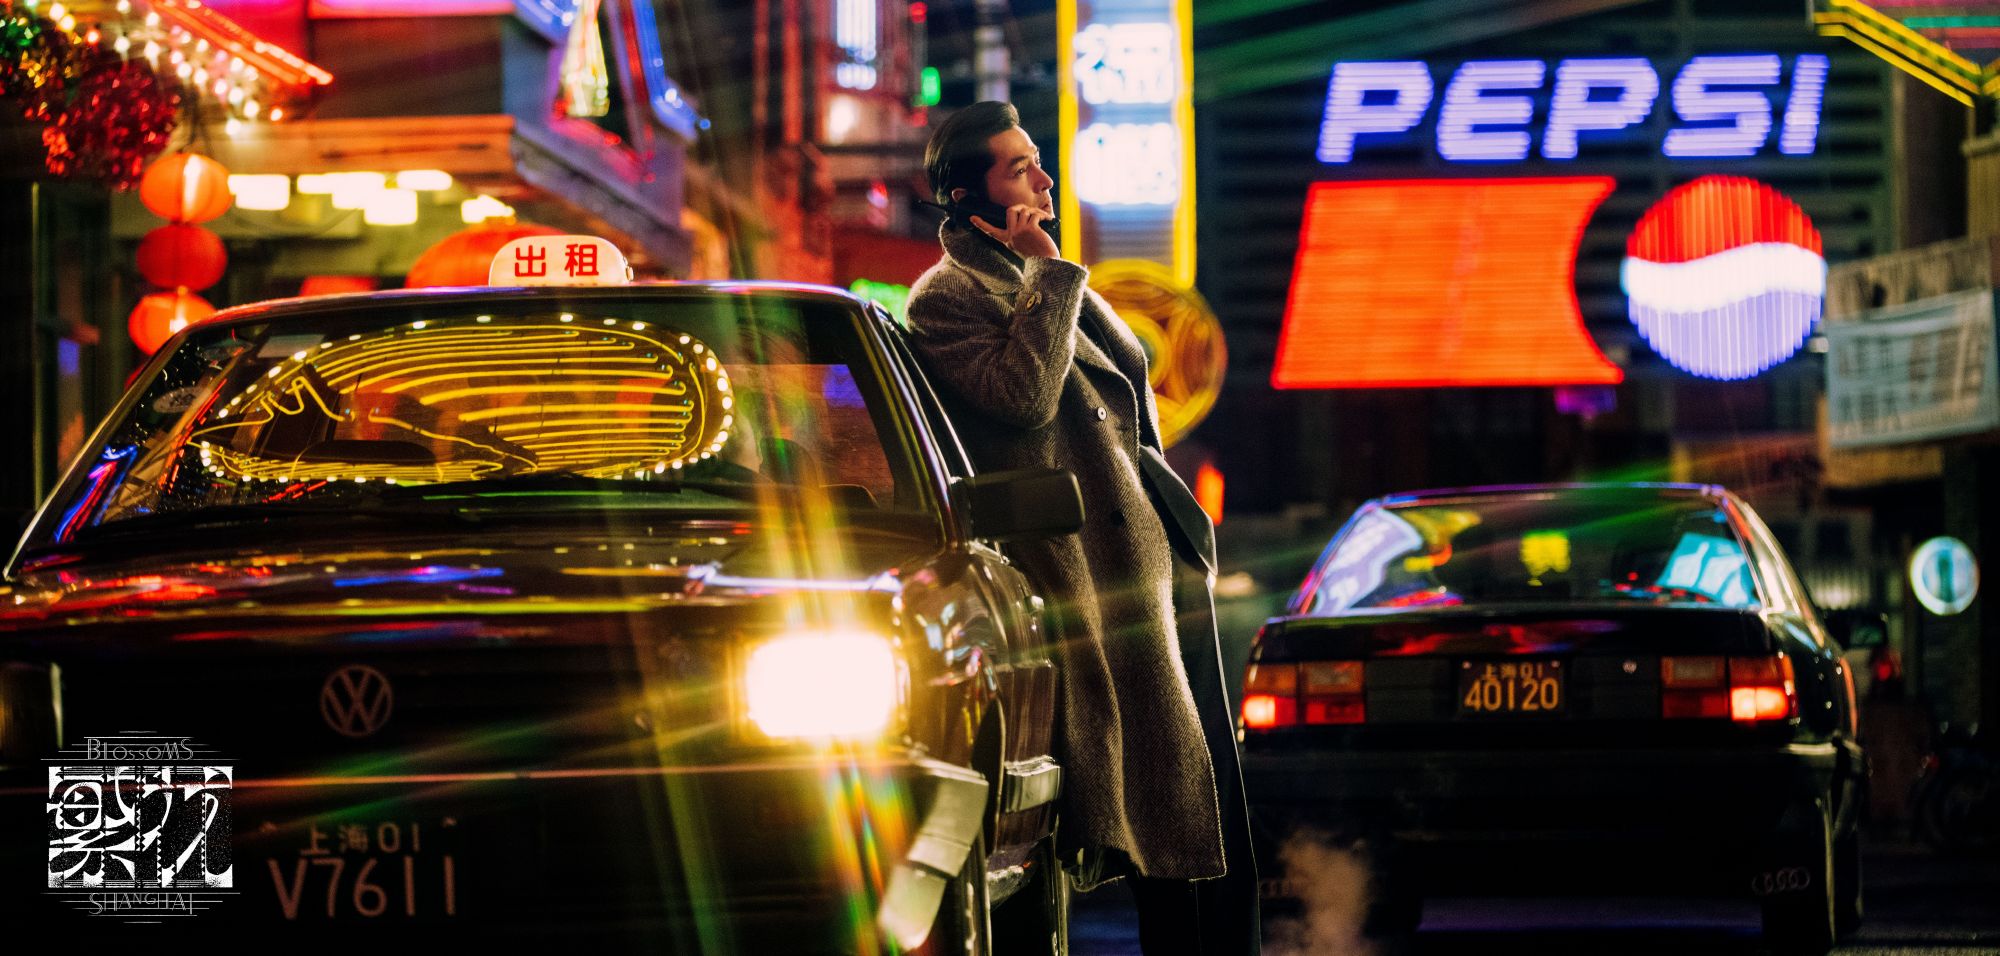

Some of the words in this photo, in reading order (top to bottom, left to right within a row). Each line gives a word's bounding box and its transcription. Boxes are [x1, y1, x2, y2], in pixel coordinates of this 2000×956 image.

[1315, 53, 1829, 164] PEPSI
[514, 243, 599, 277] 出租
[1463, 677, 1559, 711] 40120
[266, 855, 456, 920] V7611
